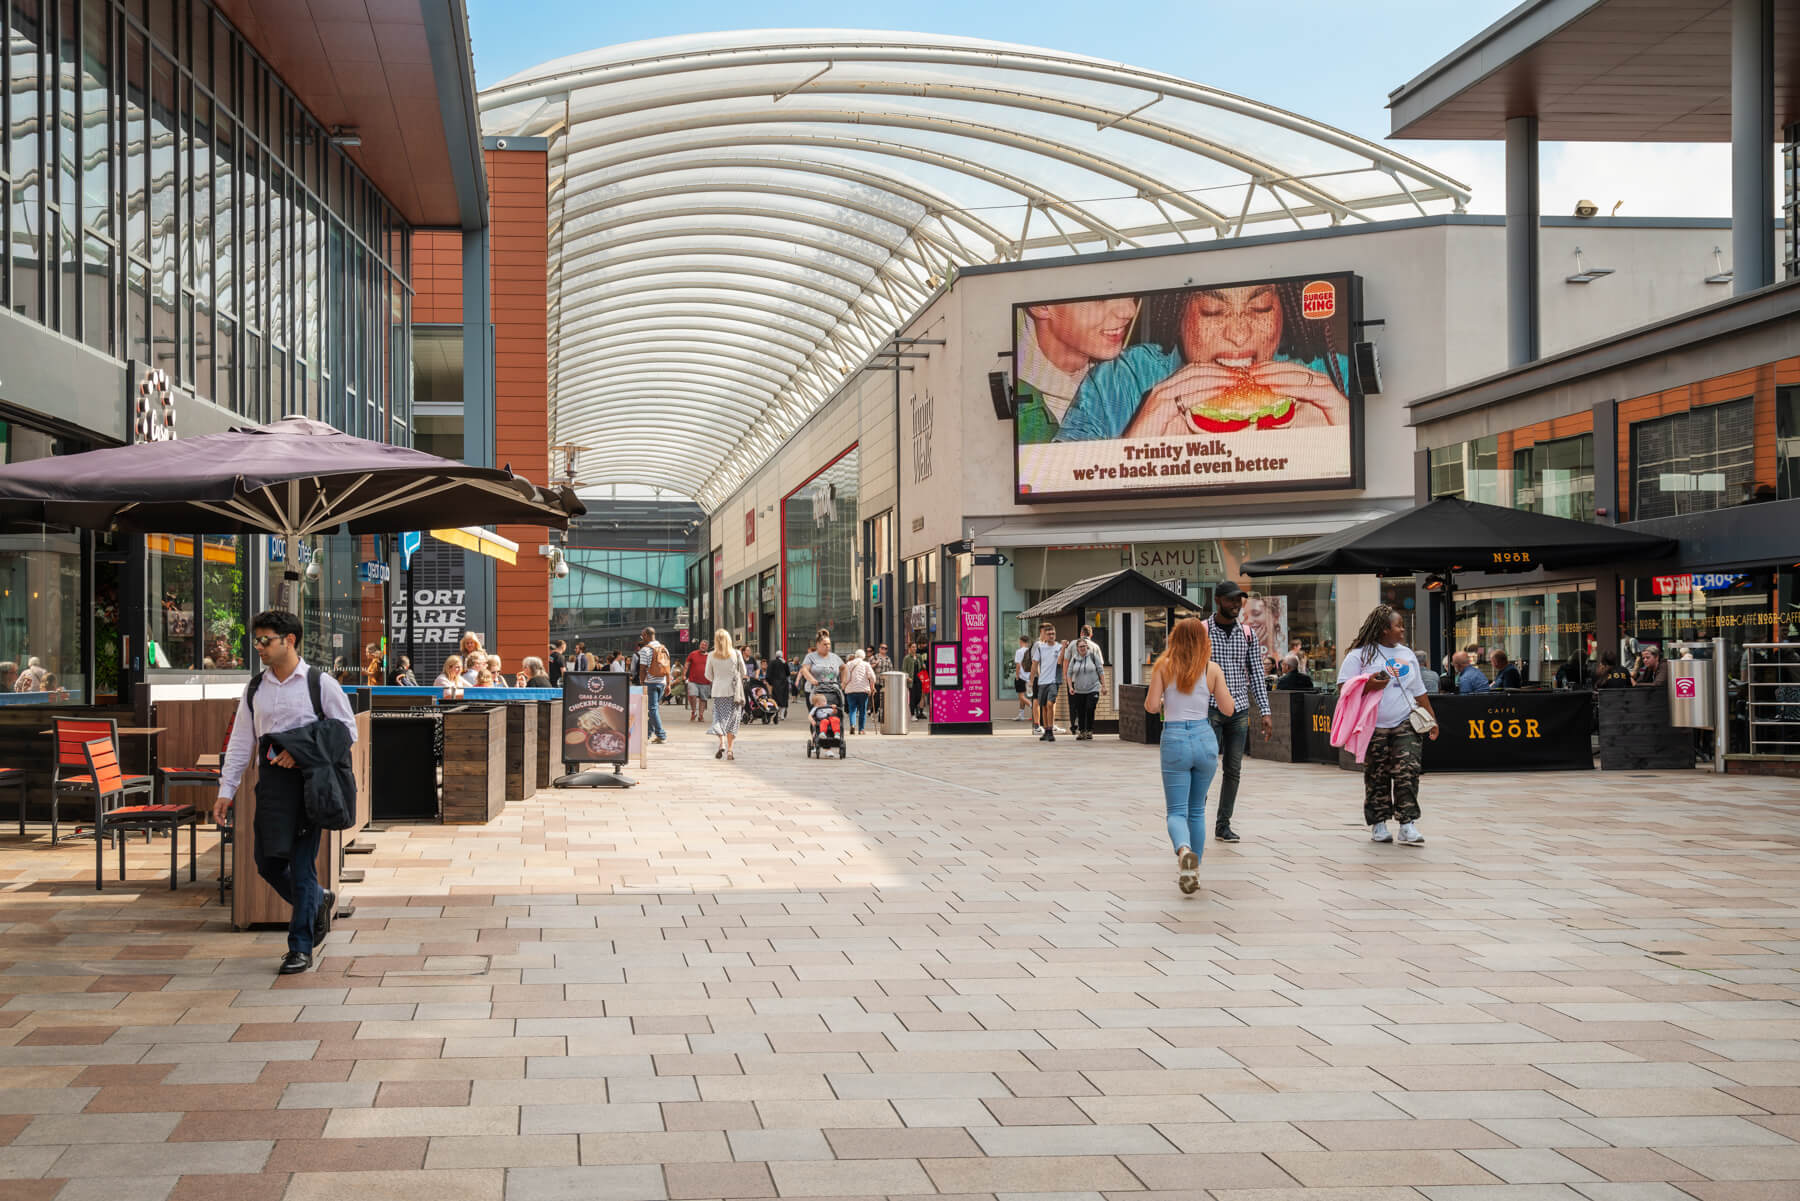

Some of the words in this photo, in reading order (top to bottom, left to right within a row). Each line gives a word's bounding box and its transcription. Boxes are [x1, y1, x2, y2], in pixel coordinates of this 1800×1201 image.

[1304, 292, 1333, 302] BURGER
[1304, 300, 1333, 311] KING
[1123, 442, 1183, 461] Trinity
[1186, 440, 1233, 458] Walk,
[1119, 462, 1158, 478] back
[1160, 460, 1191, 476] and
[1193, 459, 1233, 475] even
[1235, 456, 1289, 472] better
[1119, 549, 1220, 567] H.SAMUEL
[392, 589, 466, 605] PORT
[392, 628, 460, 643] HERE
[569, 701, 597, 711] CHICKEN
[598, 701, 624, 712] BURGER
